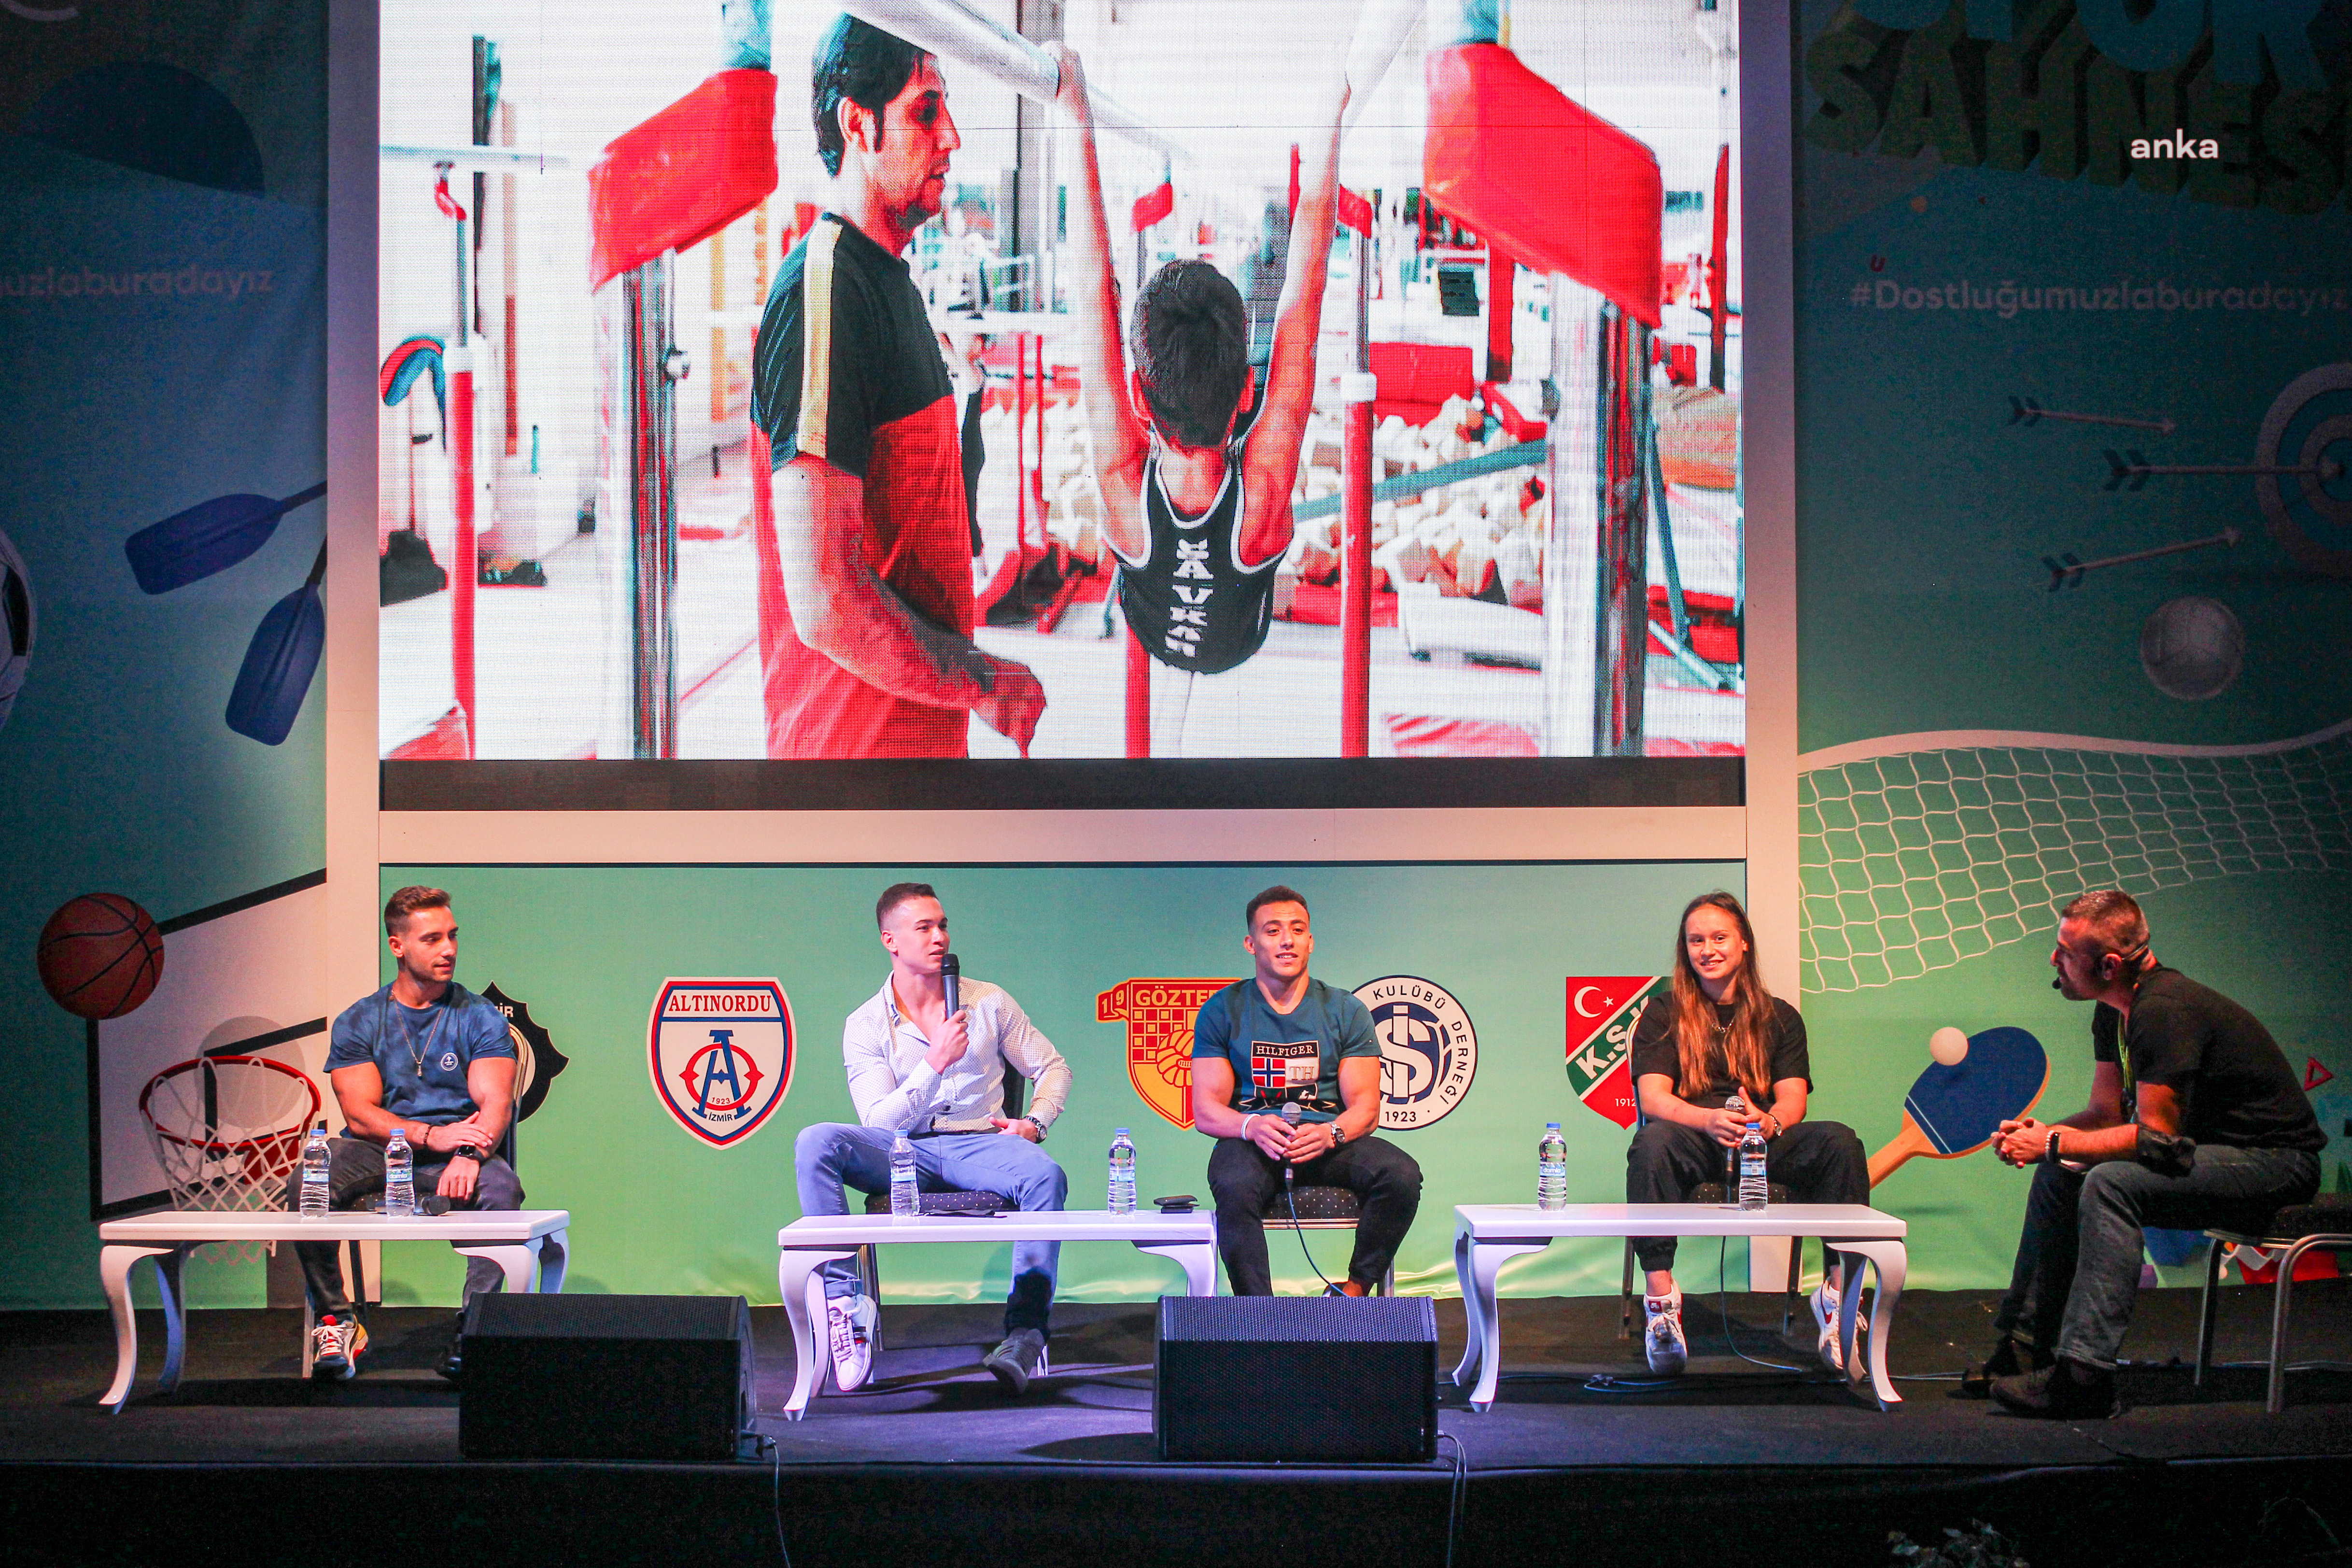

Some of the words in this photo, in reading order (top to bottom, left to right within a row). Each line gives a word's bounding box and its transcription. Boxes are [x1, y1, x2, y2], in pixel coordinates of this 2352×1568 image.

[1803, 29, 2352, 215] SAHNES
[0, 264, 273, 300] uzlaburadayız
[669, 995, 771, 1012] ALTINORDU
[1256, 1045, 1315, 1057] HILFIGER
[1373, 985, 1446, 1009] KULÜBÜ
[1440, 1021, 1468, 1104] DERNEĞİ
[1289, 1066, 1314, 1080] TH
[708, 1111, 733, 1122] İZMİR
[1385, 1111, 1417, 1122] 1923
